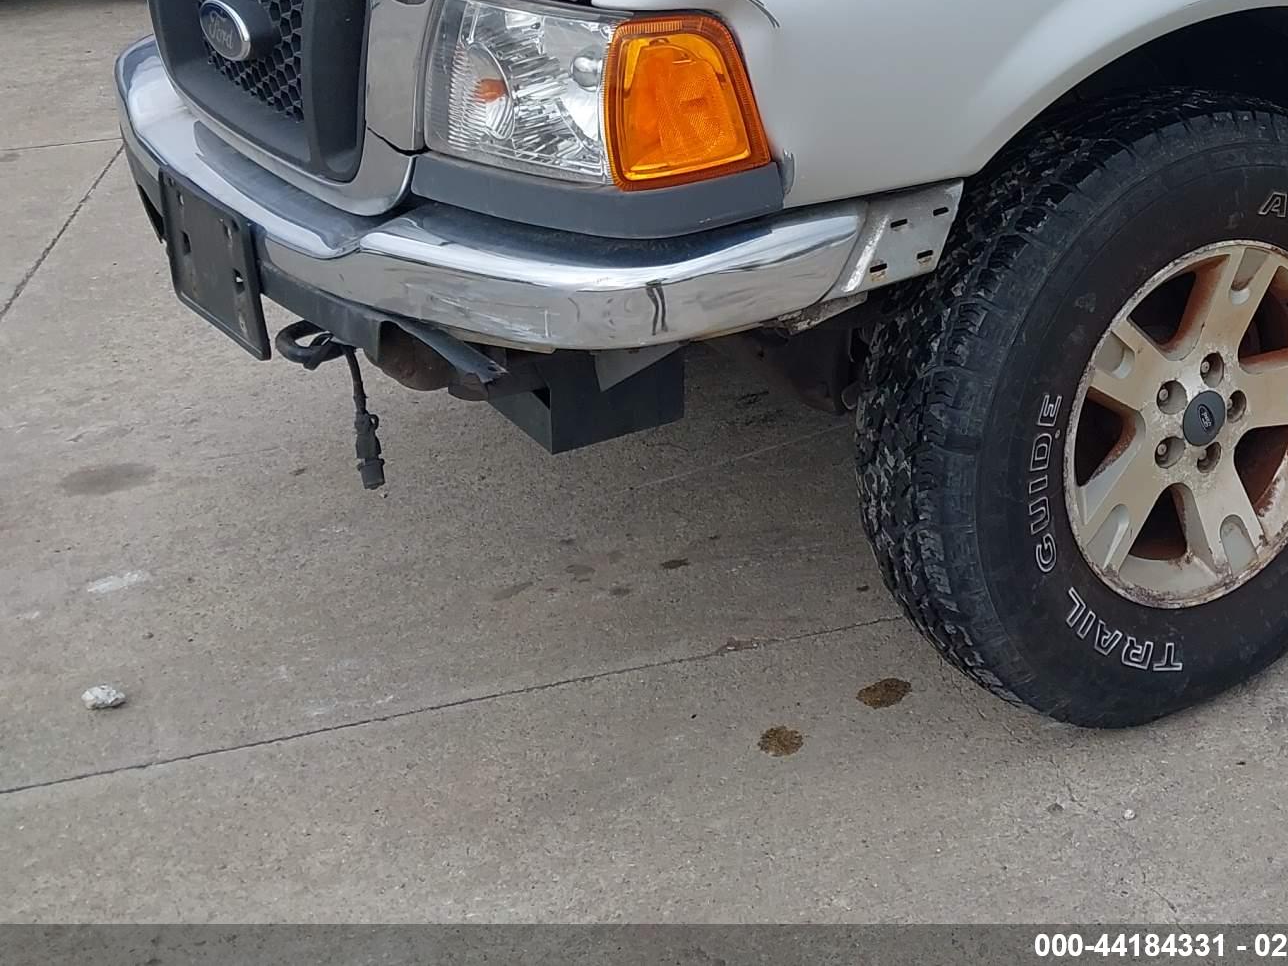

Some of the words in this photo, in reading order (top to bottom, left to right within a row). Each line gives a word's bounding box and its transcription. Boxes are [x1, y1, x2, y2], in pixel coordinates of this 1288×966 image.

[208, 10, 236, 50] Ford
[1027, 393, 1063, 574] GUIDE
[1065, 585, 1184, 673] TRAIL
